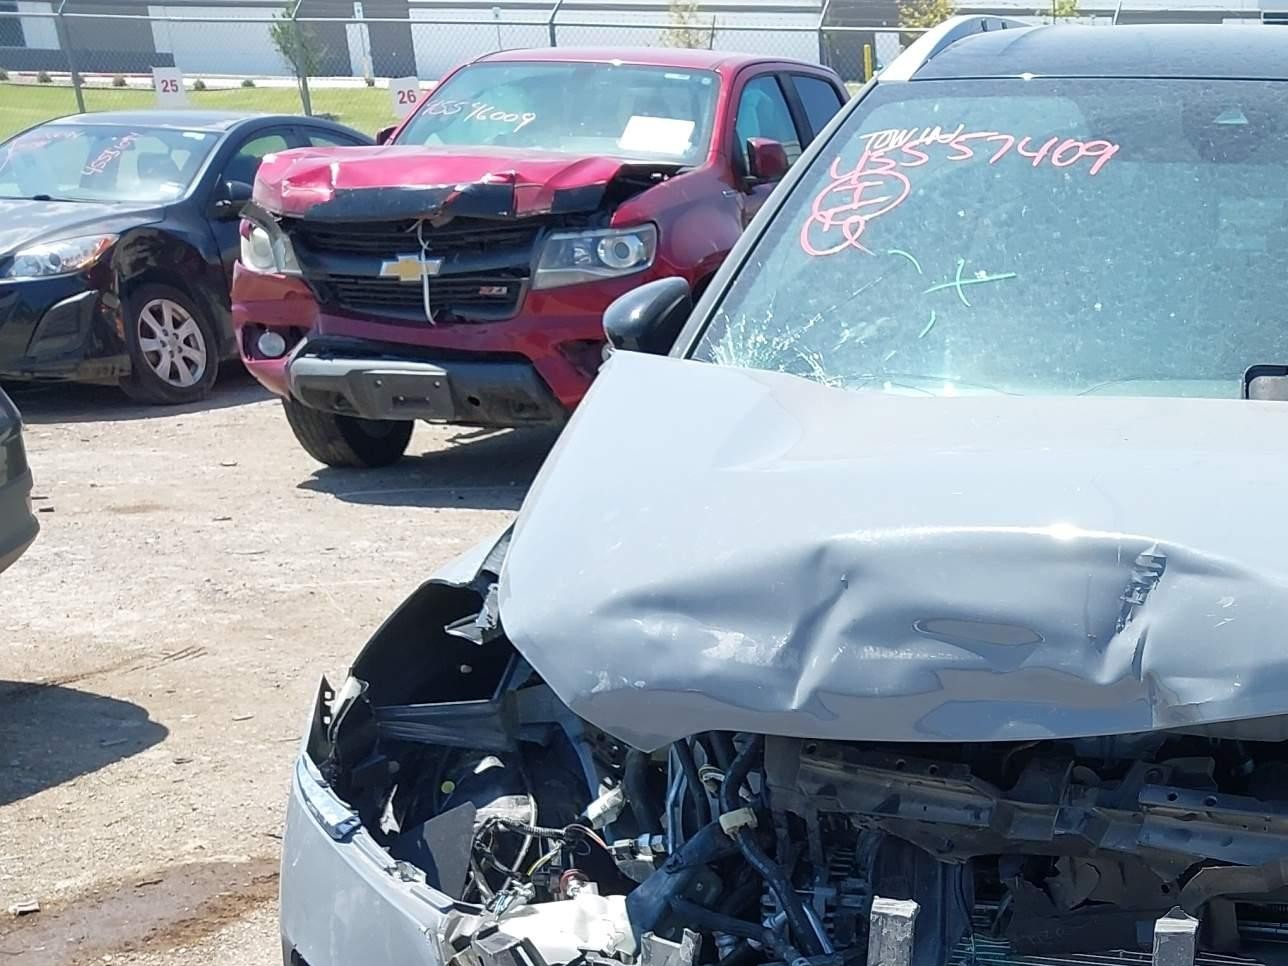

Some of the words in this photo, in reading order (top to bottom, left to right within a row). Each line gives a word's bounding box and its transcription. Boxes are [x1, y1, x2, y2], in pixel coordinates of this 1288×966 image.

[161, 79, 179, 93] 25
[397, 89, 417, 105] 26
[830, 132, 1120, 185] 45557409
